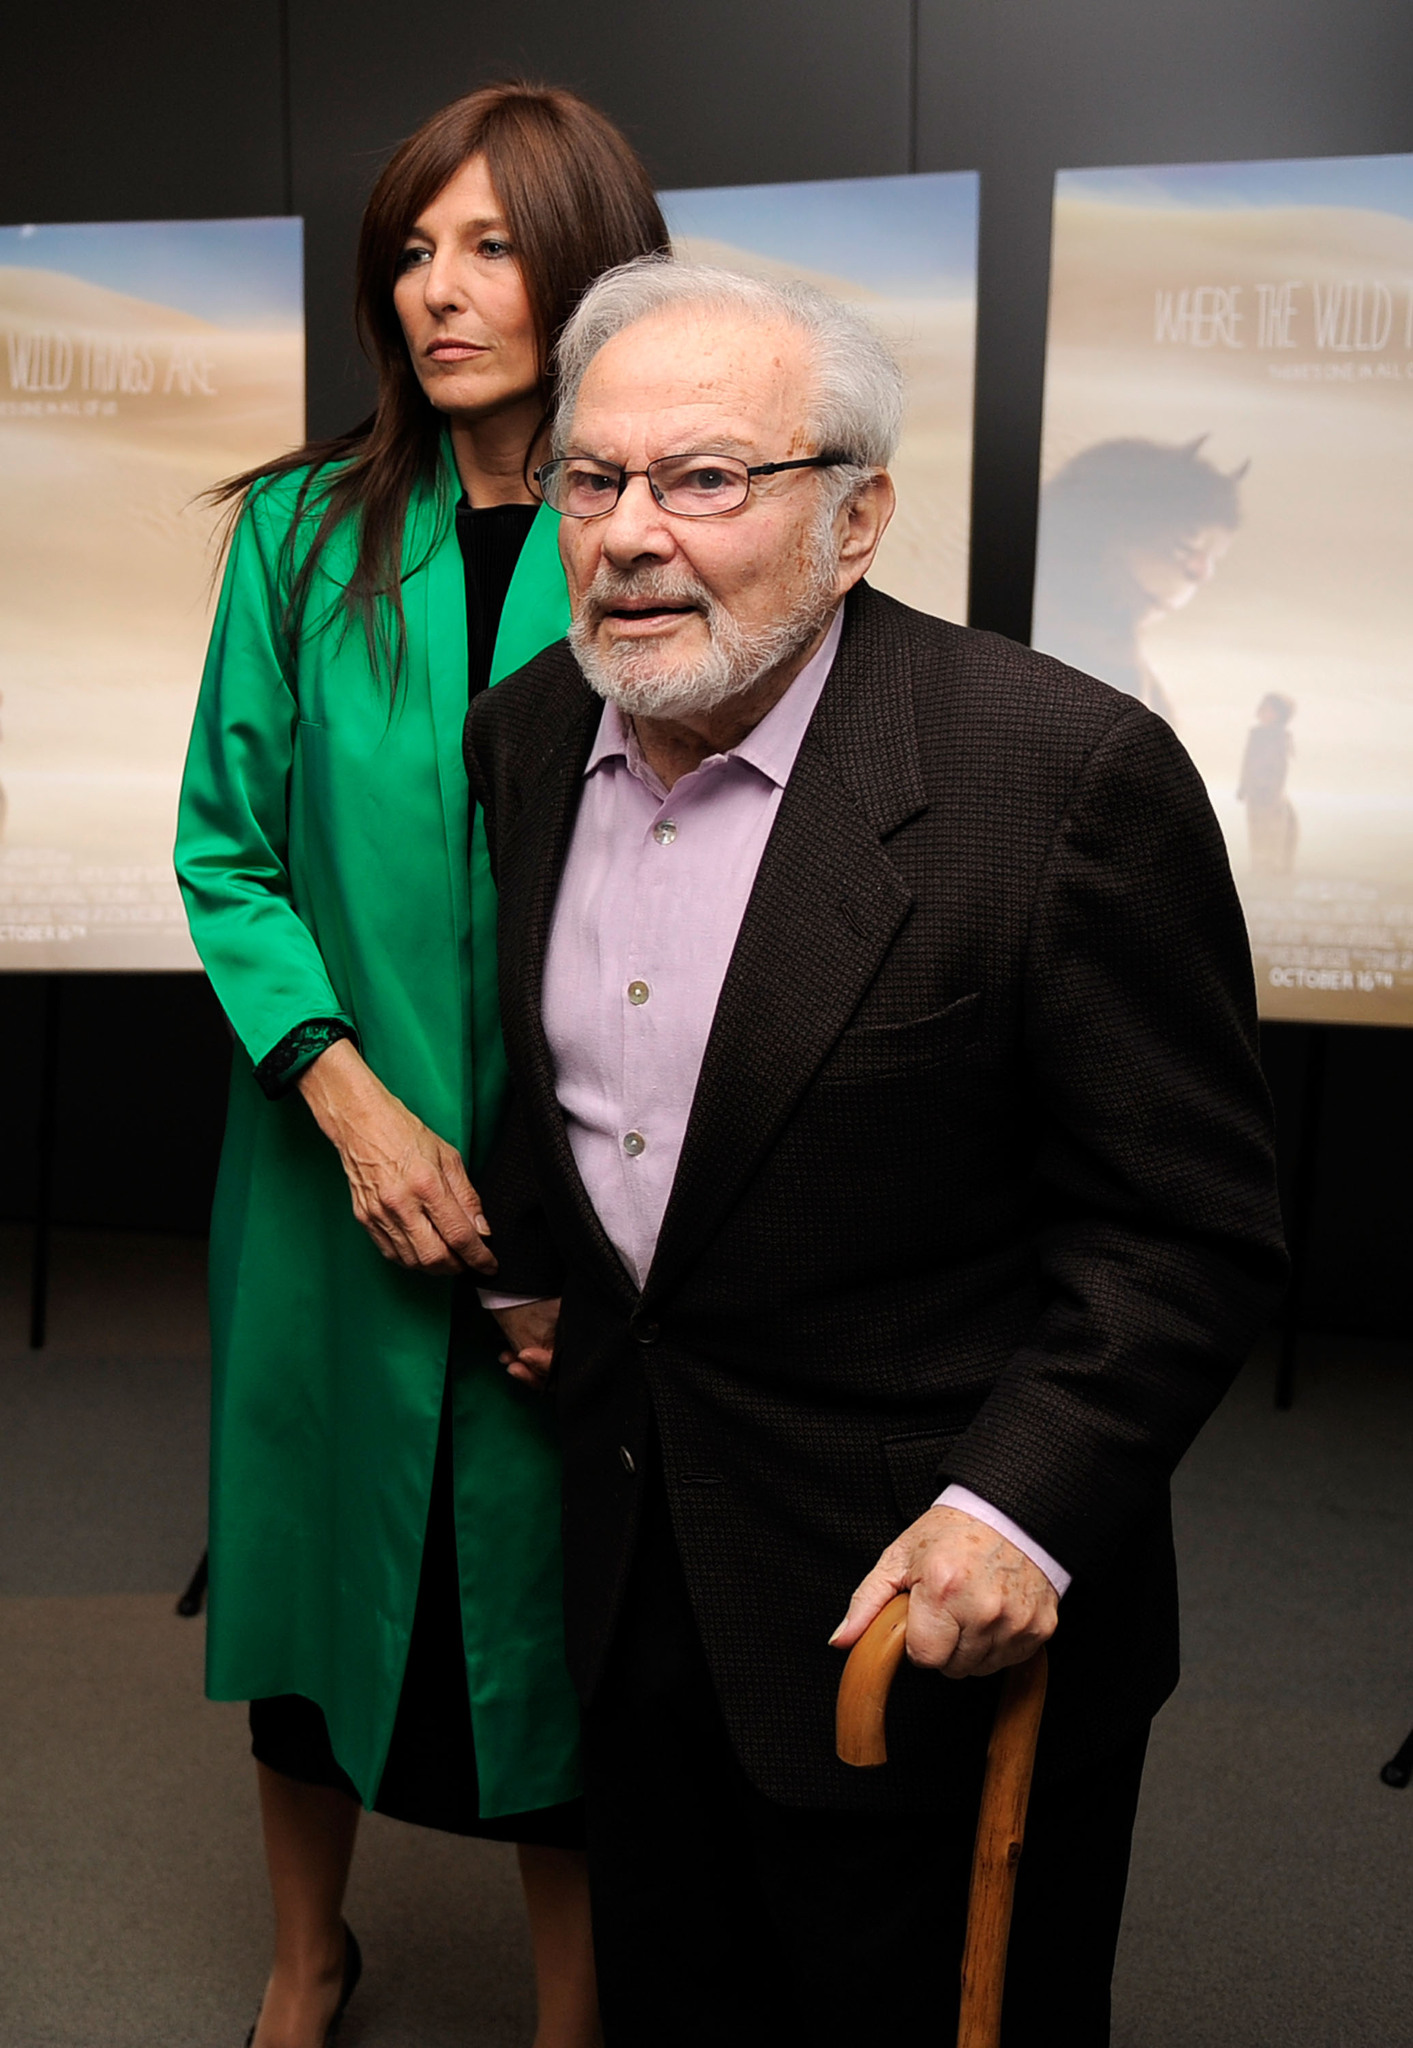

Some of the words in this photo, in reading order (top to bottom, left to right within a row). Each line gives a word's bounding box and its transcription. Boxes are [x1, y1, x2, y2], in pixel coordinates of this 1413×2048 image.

[1154, 286, 1244, 349] WHERE
[1256, 281, 1303, 349] THE
[1312, 279, 1393, 352] WILD
[7, 328, 73, 392] WILD
[80, 334, 155, 394] THINGS
[162, 338, 218, 396] ARE
[1325, 362, 1355, 381] ONE
[1359, 362, 1373, 379] IN
[1376, 361, 1402, 381] ALL
[1269, 966, 1354, 991] OCTOBER
[1357, 970, 1393, 992] 16TH
